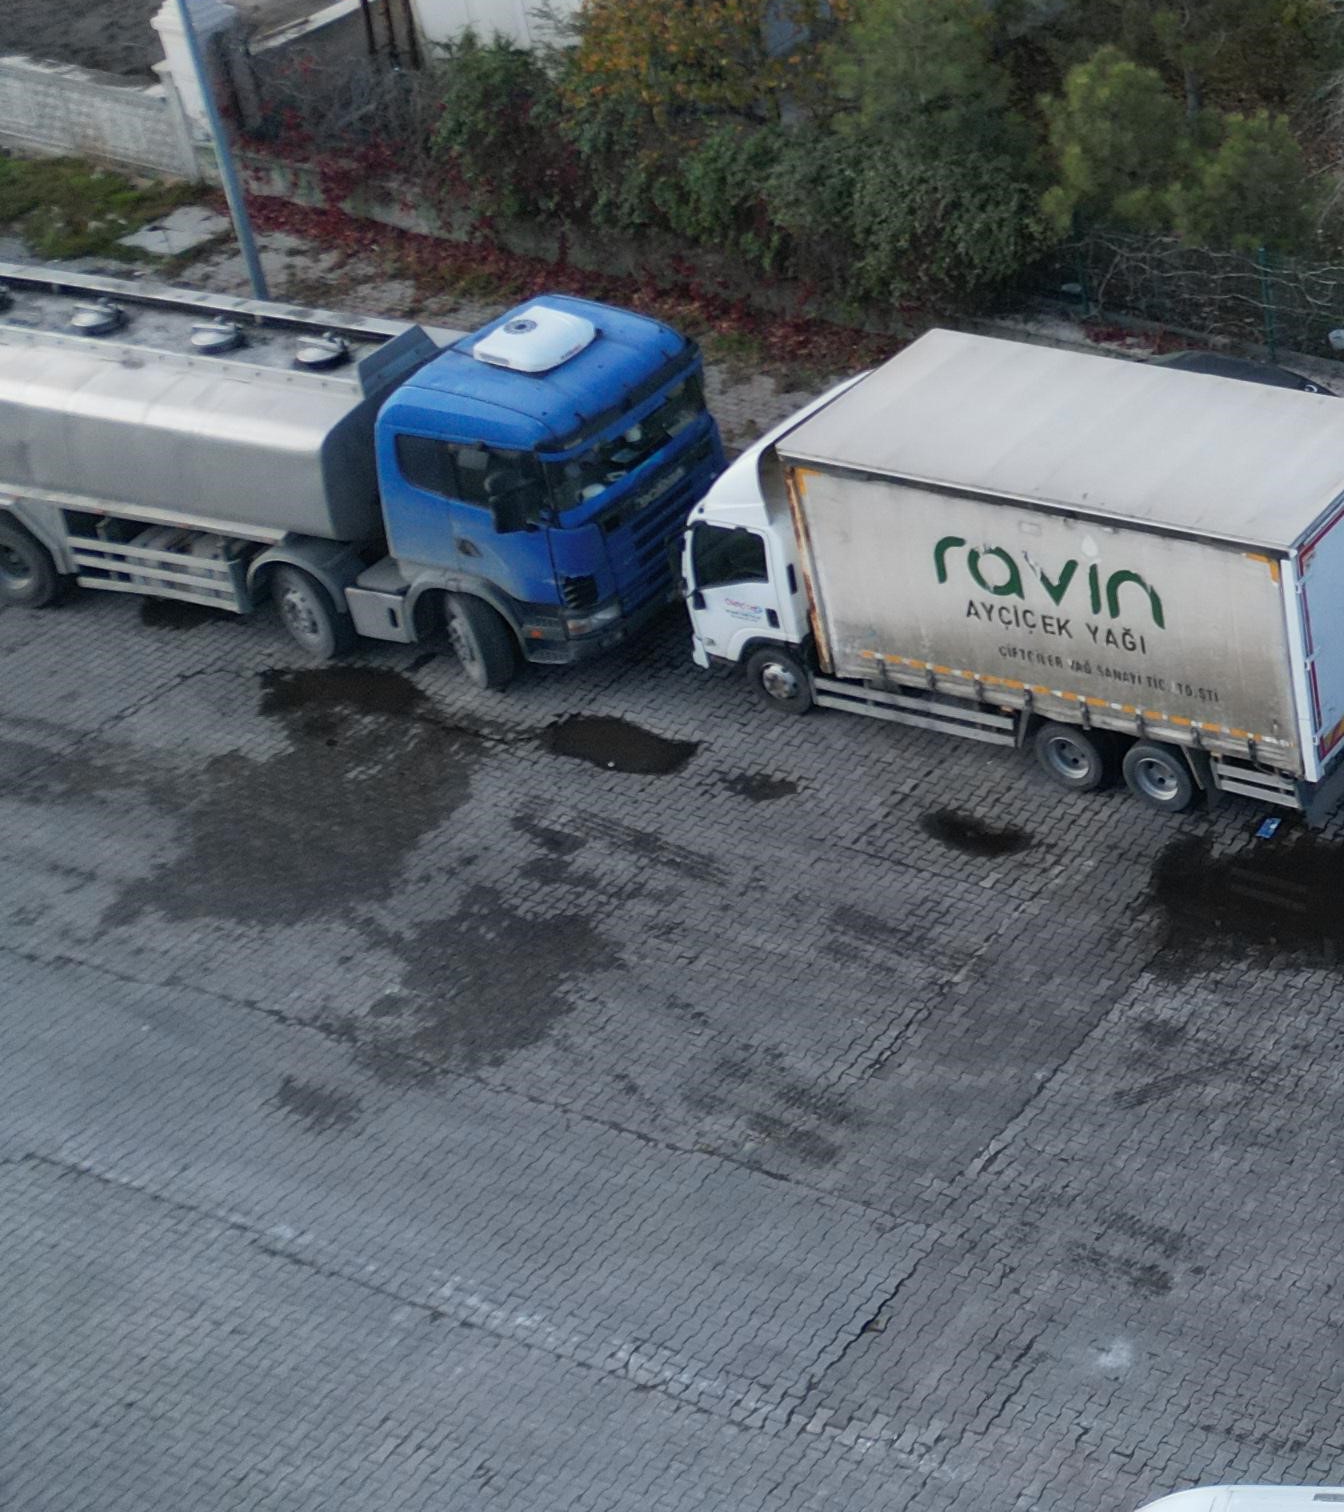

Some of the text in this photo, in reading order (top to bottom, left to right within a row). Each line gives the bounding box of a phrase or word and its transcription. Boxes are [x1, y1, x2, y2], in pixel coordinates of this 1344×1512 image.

[934, 535, 1166, 630] ravin
[966, 599, 1147, 655] AYÇİÇEK YAĞI
